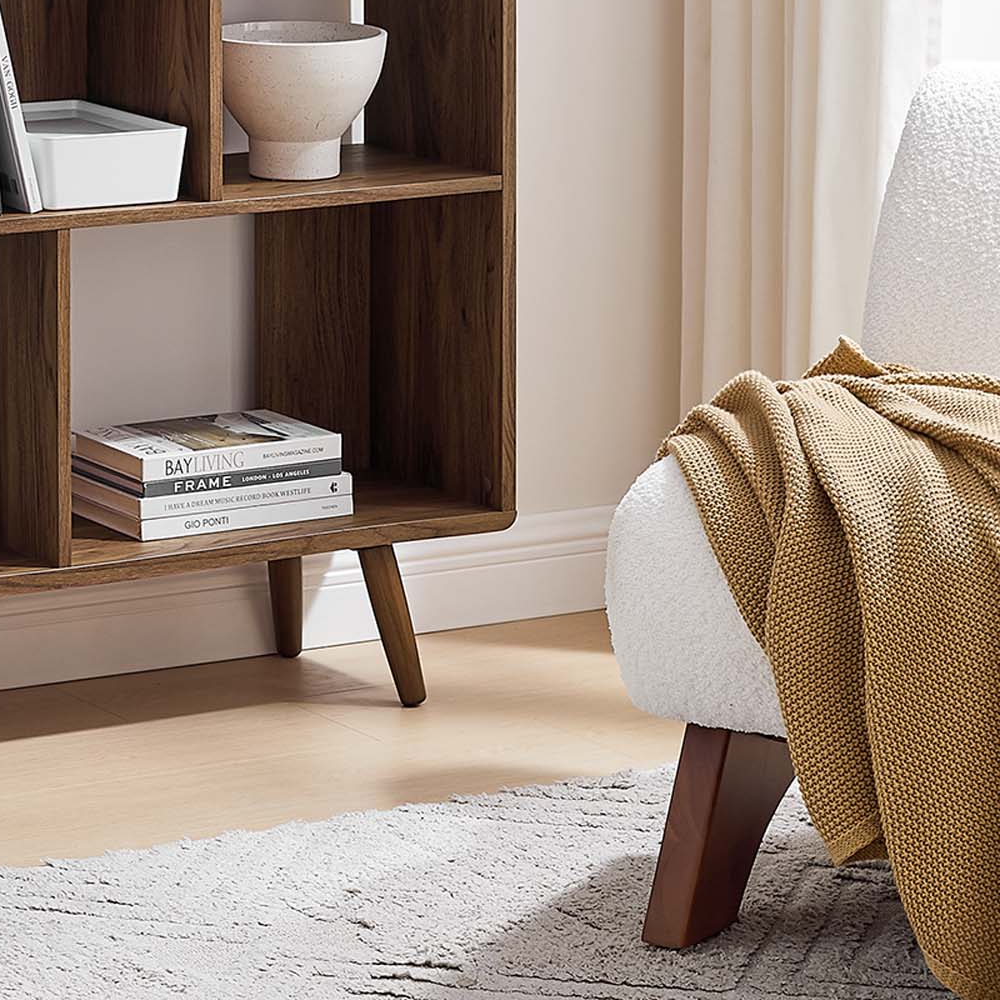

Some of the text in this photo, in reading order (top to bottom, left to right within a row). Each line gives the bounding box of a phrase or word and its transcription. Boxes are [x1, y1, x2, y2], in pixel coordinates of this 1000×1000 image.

[1, 55, 19, 110] VAN GOGH
[173, 469, 310, 494] FRAME LONDON LOS ANGELES
[167, 502, 186, 511] HAVE
[185, 500, 191, 509] A
[191, 499, 214, 509] DREAM
[214, 496, 235, 507] MUSIC
[235, 493, 261, 504] RECORD
[262, 491, 281, 502] BOOK
[280, 488, 312, 500] WESTLIFE
[184, 518, 201, 530] GIO
[202, 515, 230, 528] PONTI
